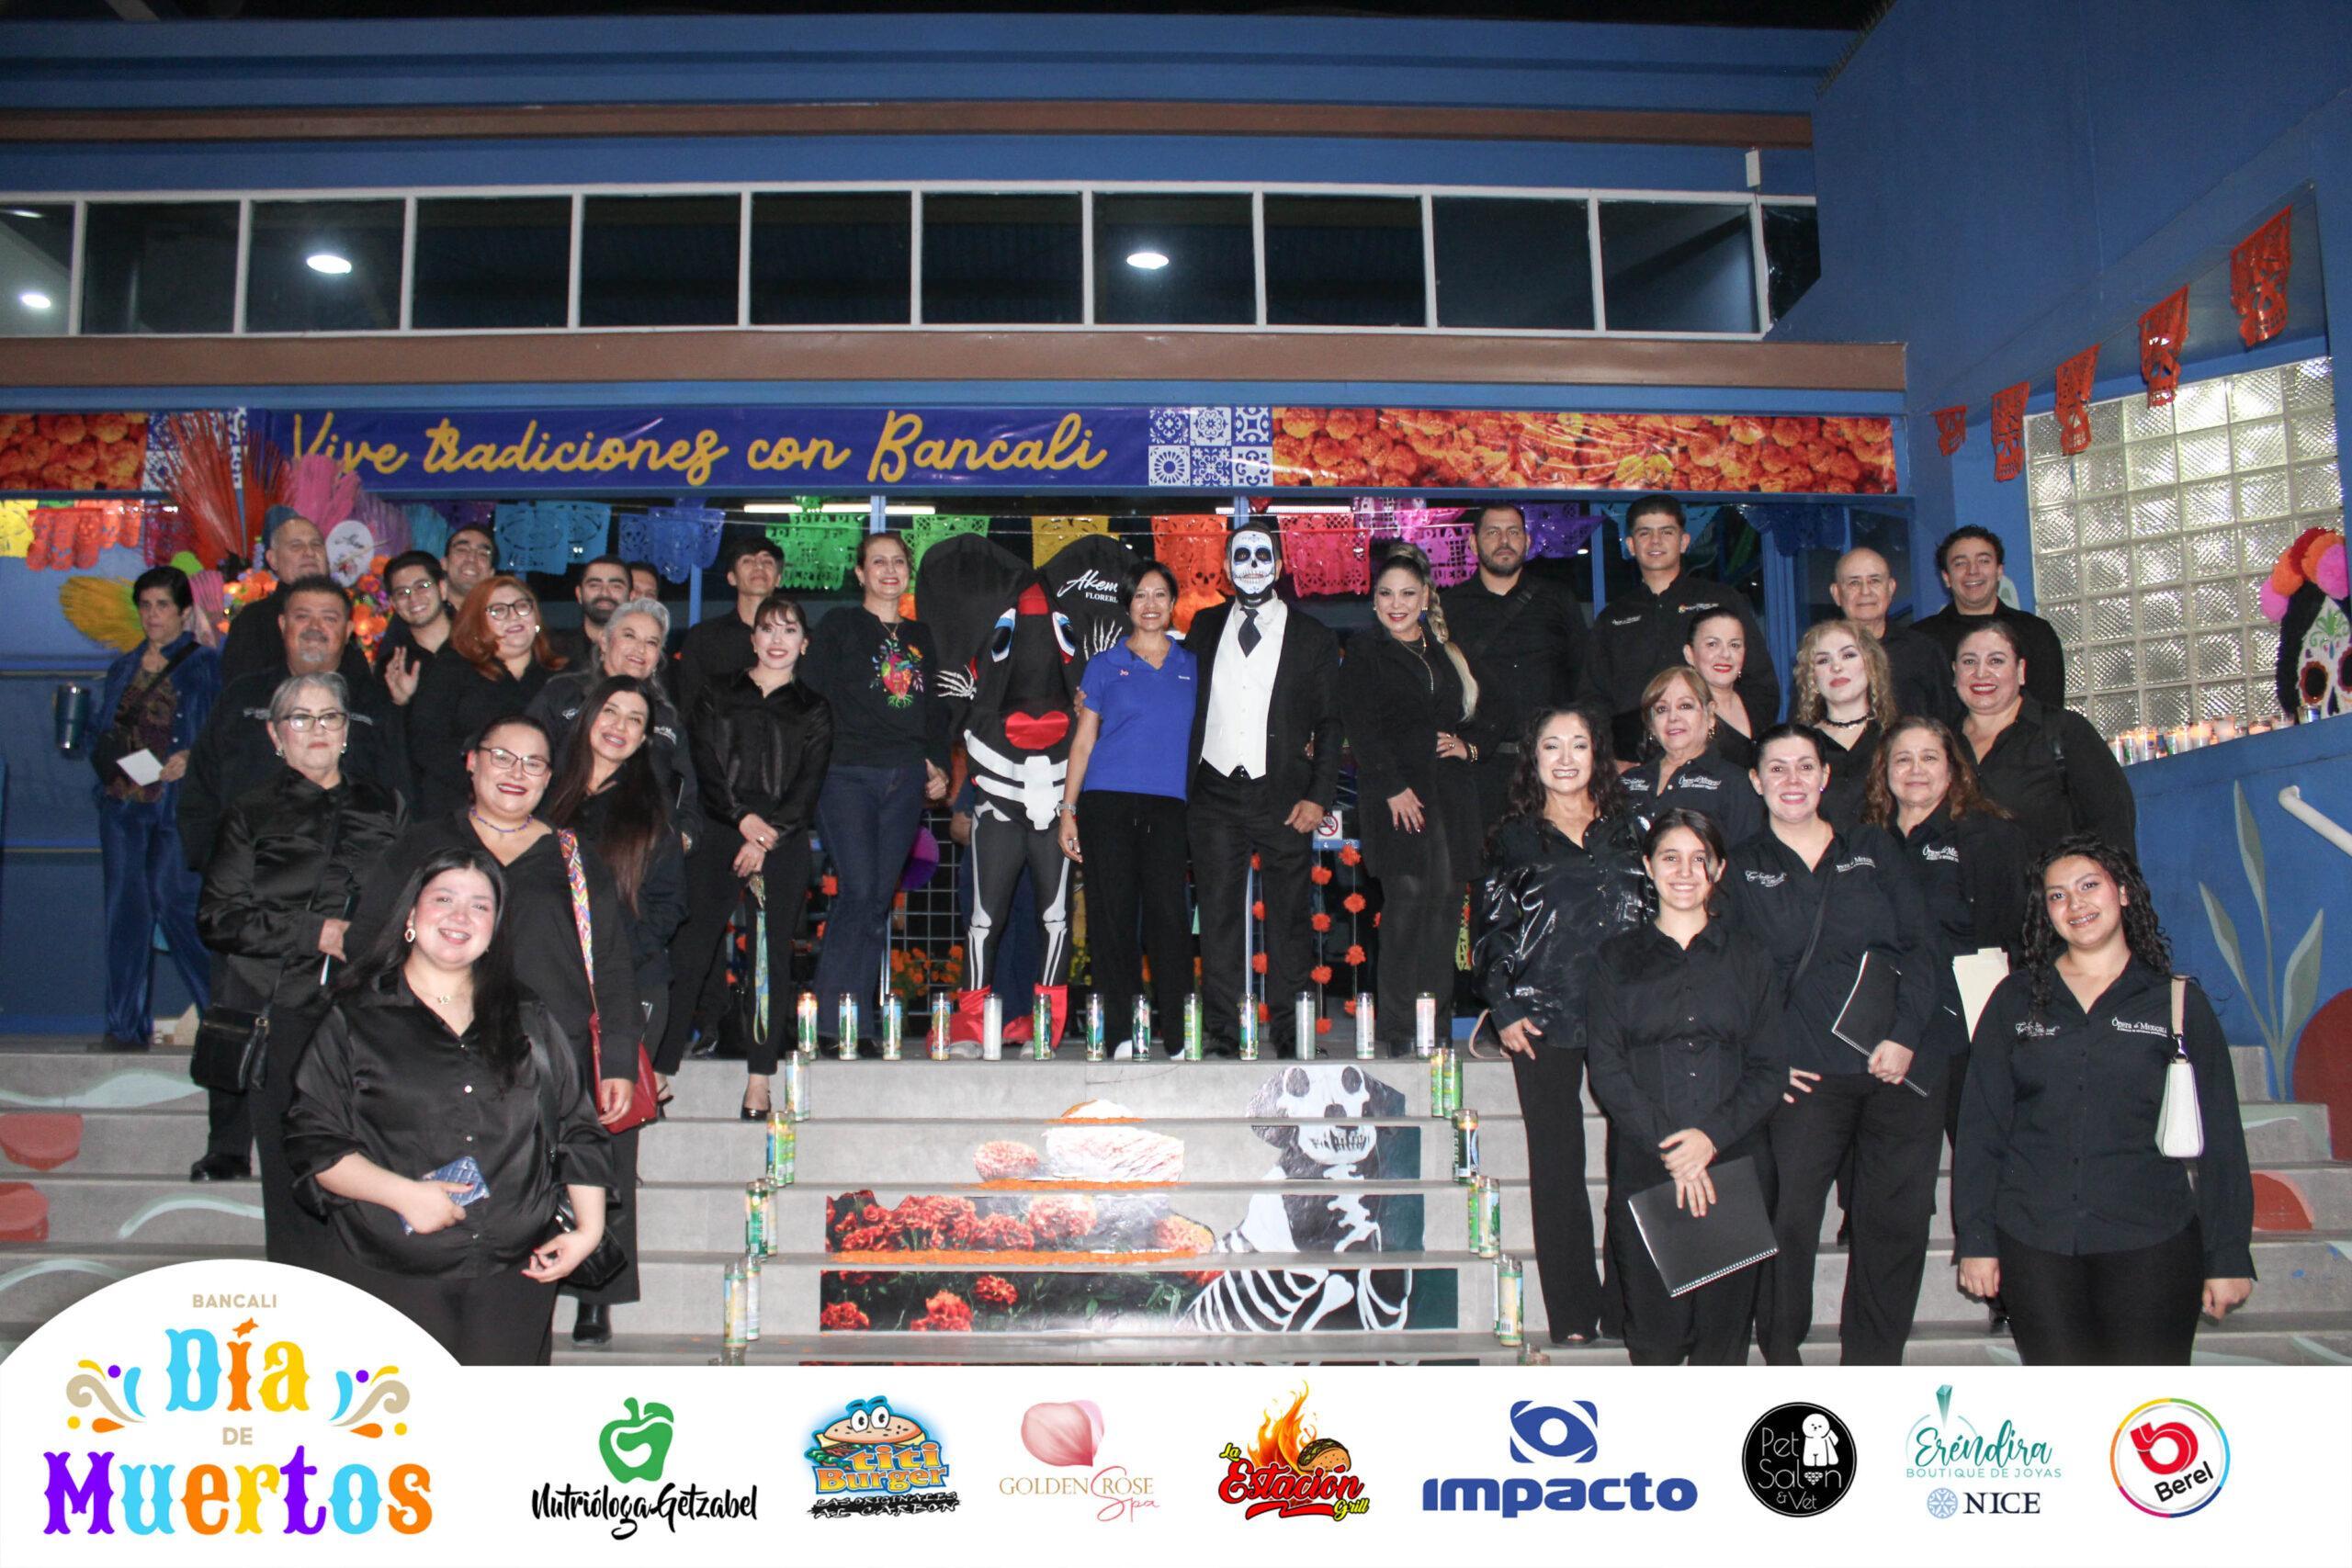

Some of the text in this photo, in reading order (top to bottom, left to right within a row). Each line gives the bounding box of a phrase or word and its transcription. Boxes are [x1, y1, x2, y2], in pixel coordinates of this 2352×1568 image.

[293, 410, 1108, 487] Vive tradiciones con Bancali
